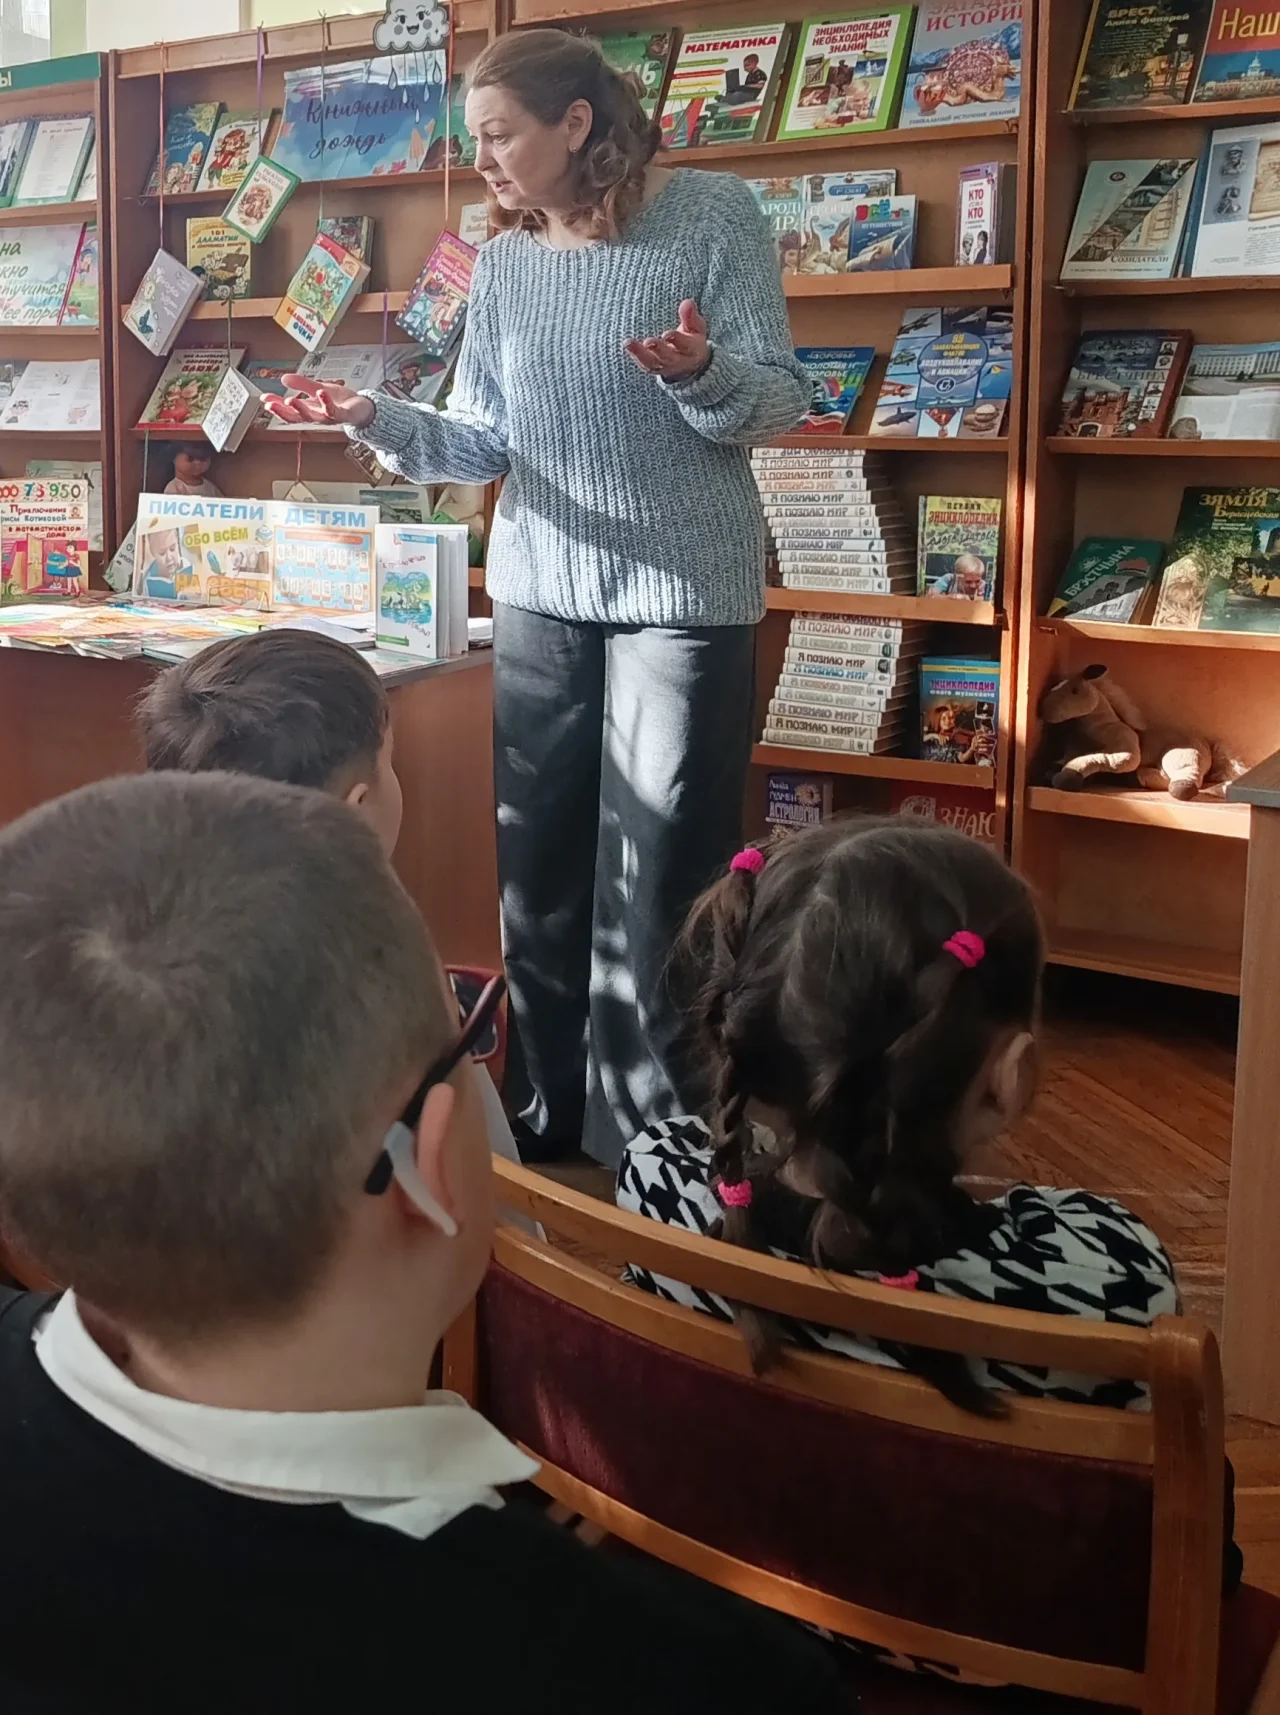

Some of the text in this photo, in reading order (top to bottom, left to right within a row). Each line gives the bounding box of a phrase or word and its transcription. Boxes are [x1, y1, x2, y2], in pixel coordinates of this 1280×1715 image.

[1108, 6, 1157, 19] БРЕСТ
[815, 20, 892, 36] ЭНЦИКЛОПЕДИЯ
[685, 36, 777, 53] МАТЕМАТИКА
[812, 29, 890, 46] НЕОБХОДИМЫХ
[828, 41, 868, 54] ЗНАНИЙ
[306, 94, 419, 124] Книжный
[309, 134, 387, 159] дождь
[968, 189, 984, 201] КТО
[968, 207, 983, 219] КТО
[23, 307, 60, 323] пора
[293, 321, 313, 342] ОЧКИ
[769, 471, 809, 479] ПОЗНАЮ
[812, 470, 834, 479] МИР
[780, 494, 820, 503] ПОЗНАЮ
[823, 493, 844, 502] МИР
[9, 504, 67, 515] Приключения
[148, 500, 264, 521] ПИСАТЕЛИ
[285, 508, 366, 527] ДЕТЯМ
[785, 507, 825, 517] ПОЗНАЮ
[827, 507, 848, 516] МИР
[947, 502, 981, 510] ПЕРВАЯ
[928, 511, 998, 525] ЭНЦИКЛОПЕДИЯ
[184, 527, 249, 548] ОБО ВСЁМ
[791, 528, 830, 537] ПОЗНАЮ
[833, 528, 854, 537] МИР
[1064, 545, 1135, 596] БРЭСТЧЫНА
[175, 574, 201, 592] НА
[808, 622, 851, 634] ПОЗНАЮ
[854, 627, 876, 638] МИР
[807, 654, 843, 665] ПОЗНАЮ
[846, 659, 865, 668] МИР
[804, 665, 844, 677] ПОЗНАЮ
[846, 670, 868, 680] МИР
[788, 704, 832, 717] ПОЗНАЮ
[835, 710, 859, 720] МИР
[786, 720, 827, 732] ПОЗНАЮ
[831, 725, 853, 735] МИР
[769, 801, 820, 824] АСТРОЛОГИЯ
